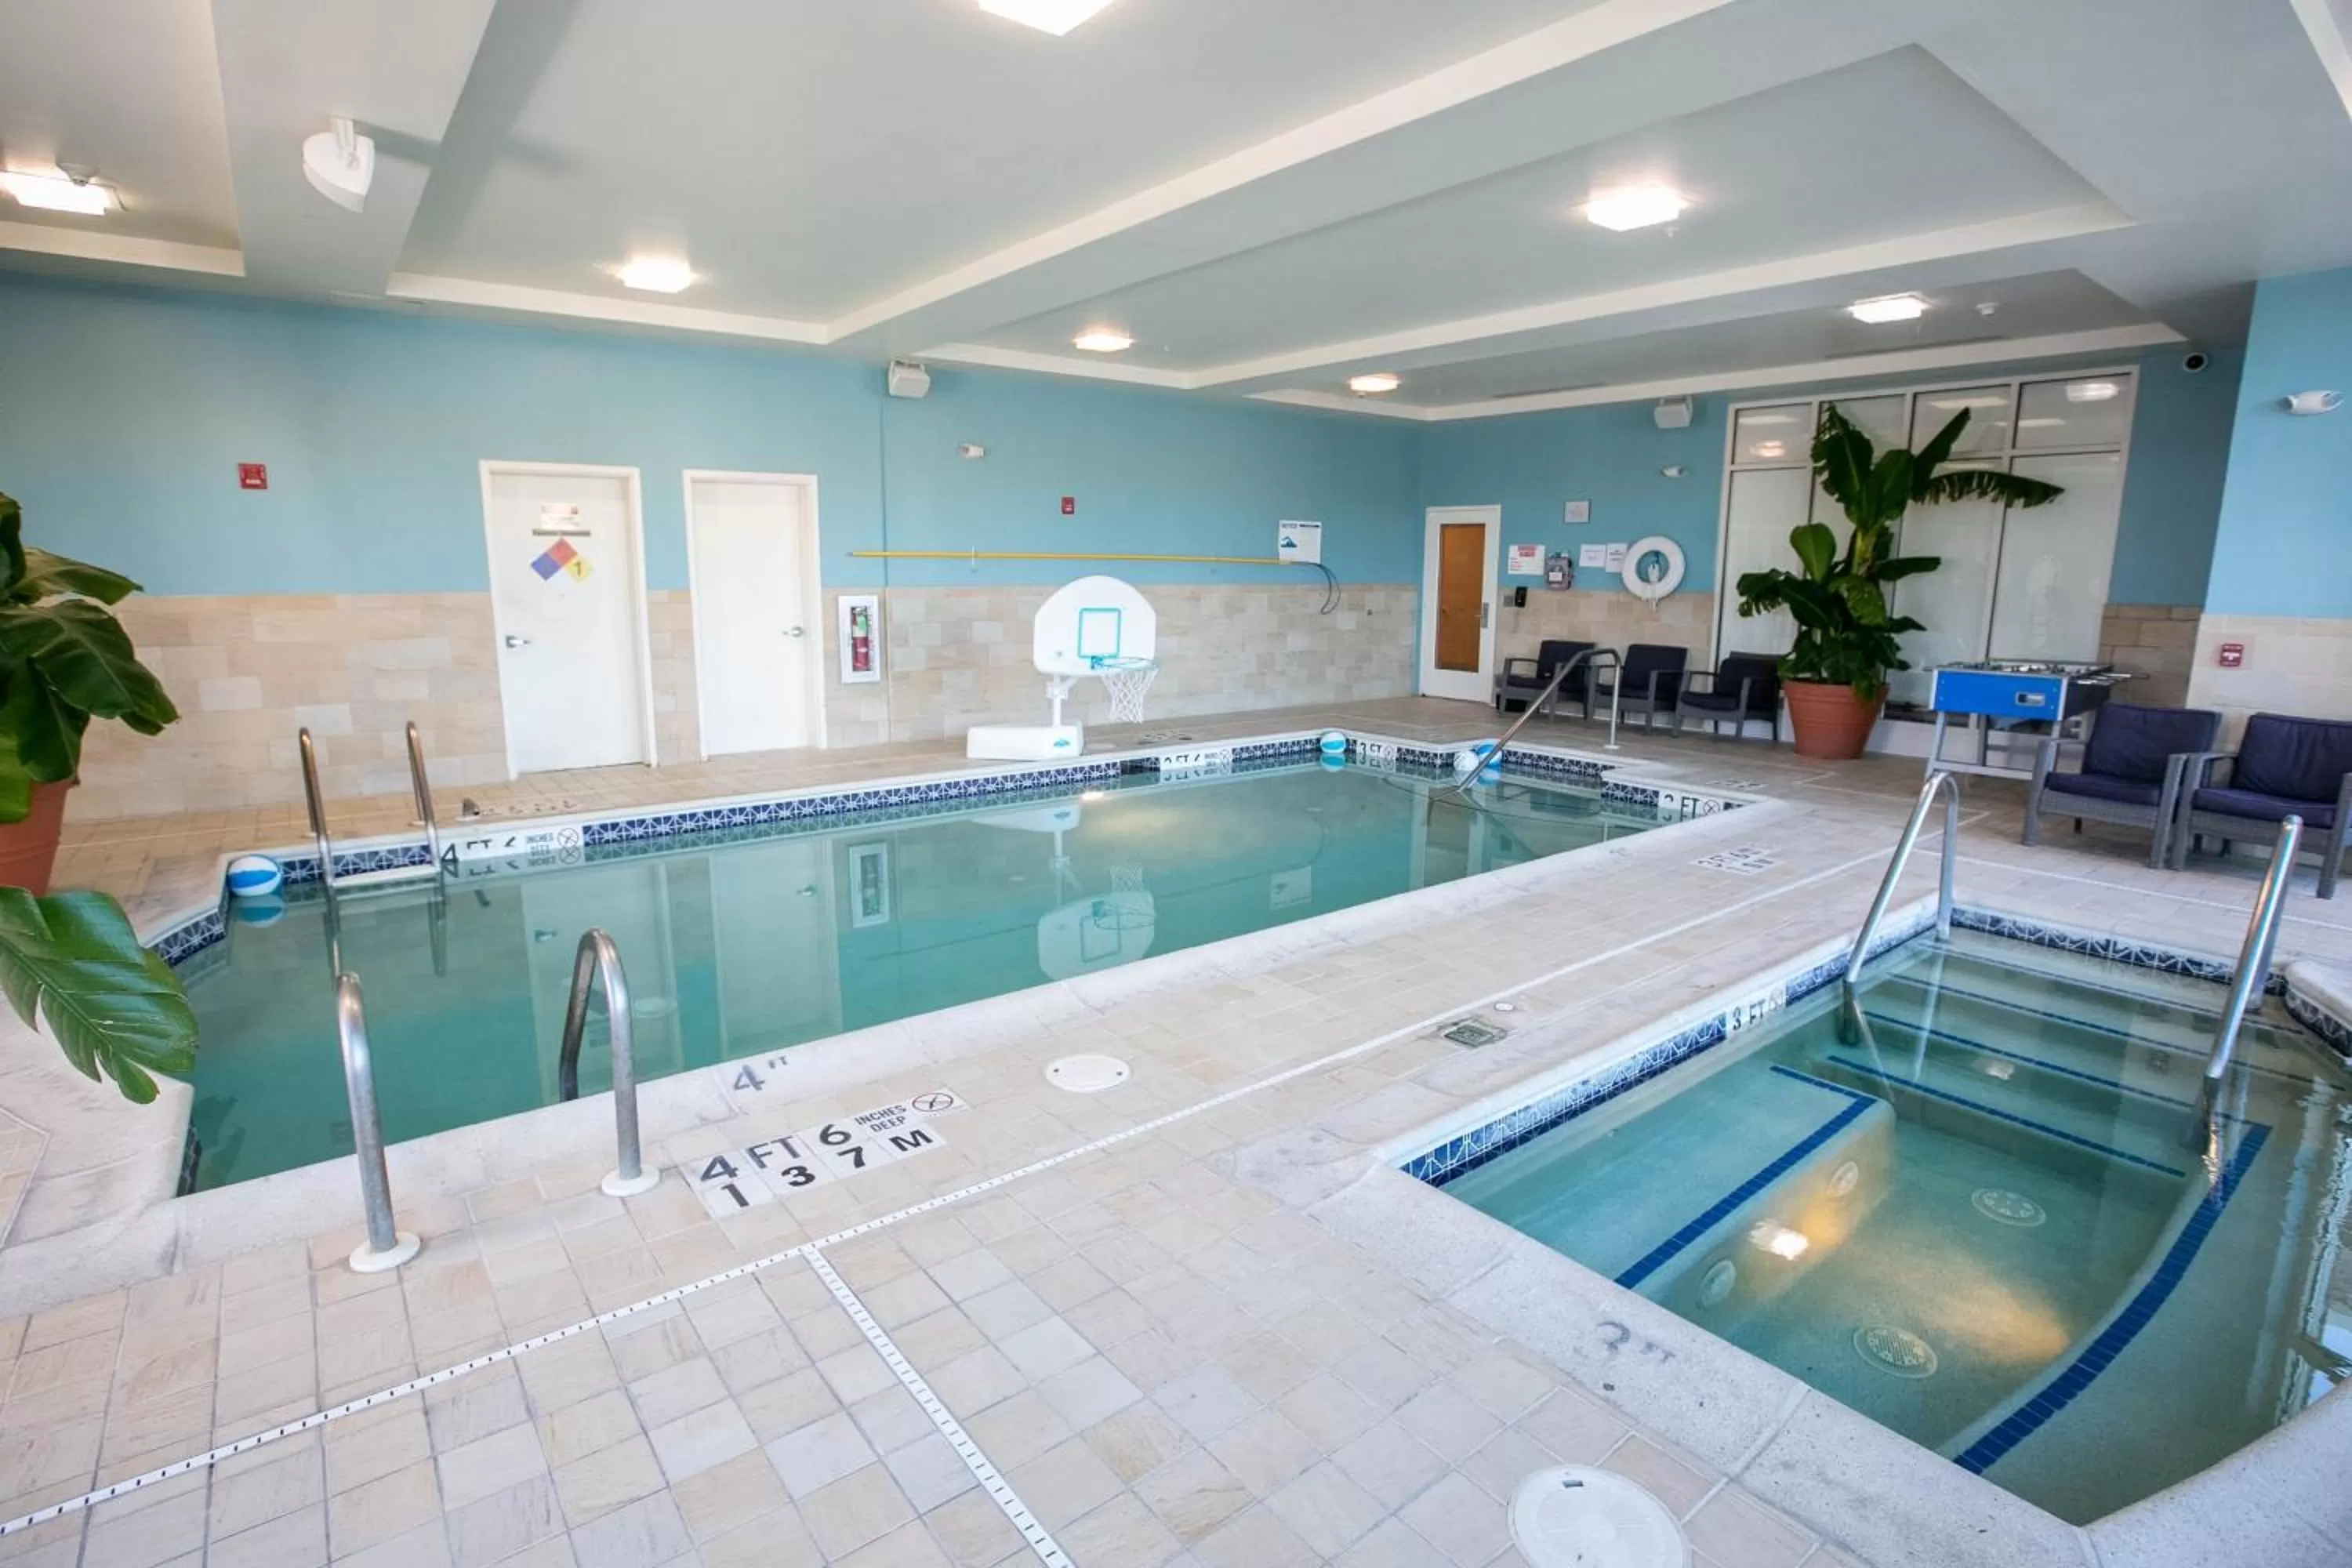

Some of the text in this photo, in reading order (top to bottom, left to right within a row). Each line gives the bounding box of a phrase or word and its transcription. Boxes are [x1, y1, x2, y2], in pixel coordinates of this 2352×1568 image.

[734, 1065, 766, 1092] 4
[700, 1105, 907, 1182] 4 FT 6 INCHES
[869, 1116, 906, 1133] DEEP
[720, 1129, 933, 1207] 1 3 7 M
